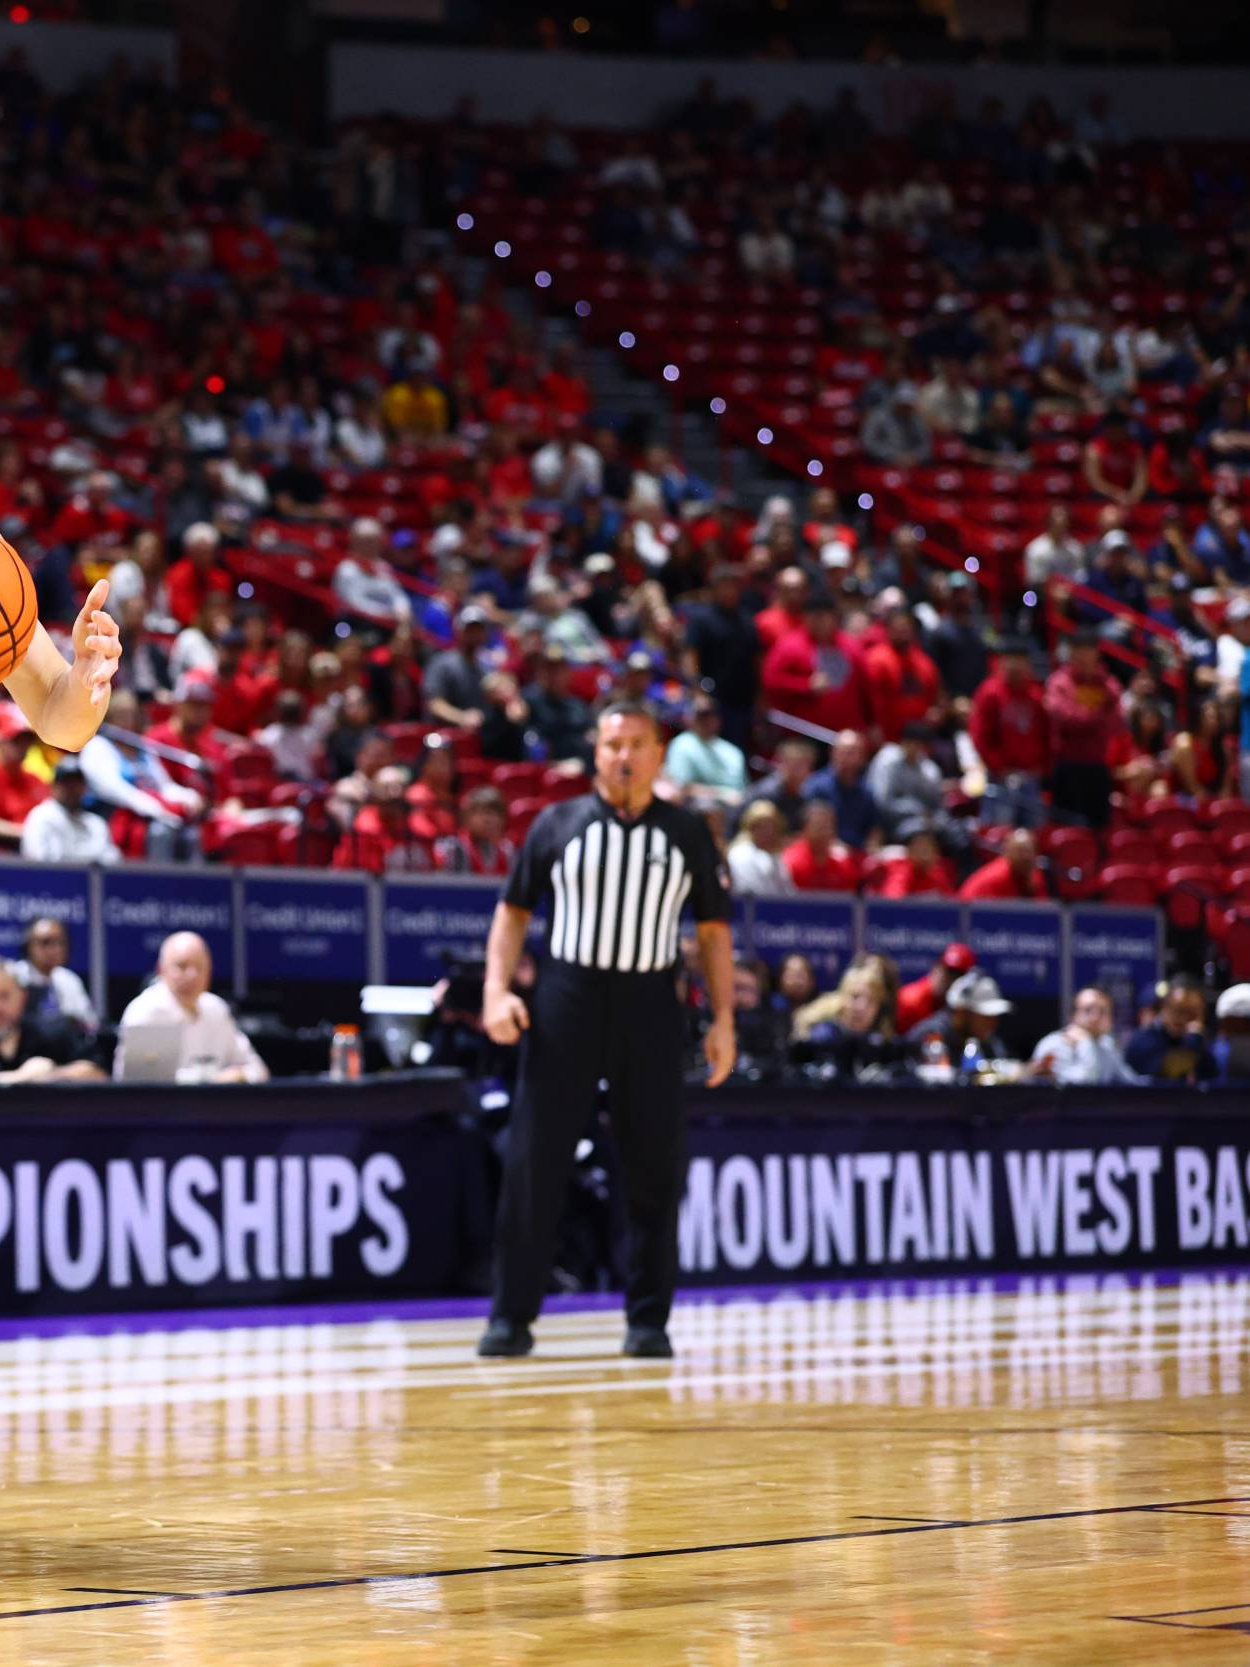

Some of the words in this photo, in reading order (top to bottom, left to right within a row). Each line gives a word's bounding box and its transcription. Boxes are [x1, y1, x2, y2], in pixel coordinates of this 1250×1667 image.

[677, 1151, 994, 1272] MOUNTAIN
[1006, 1146, 1161, 1259] WEST
[1174, 1145, 1250, 1250] BA
